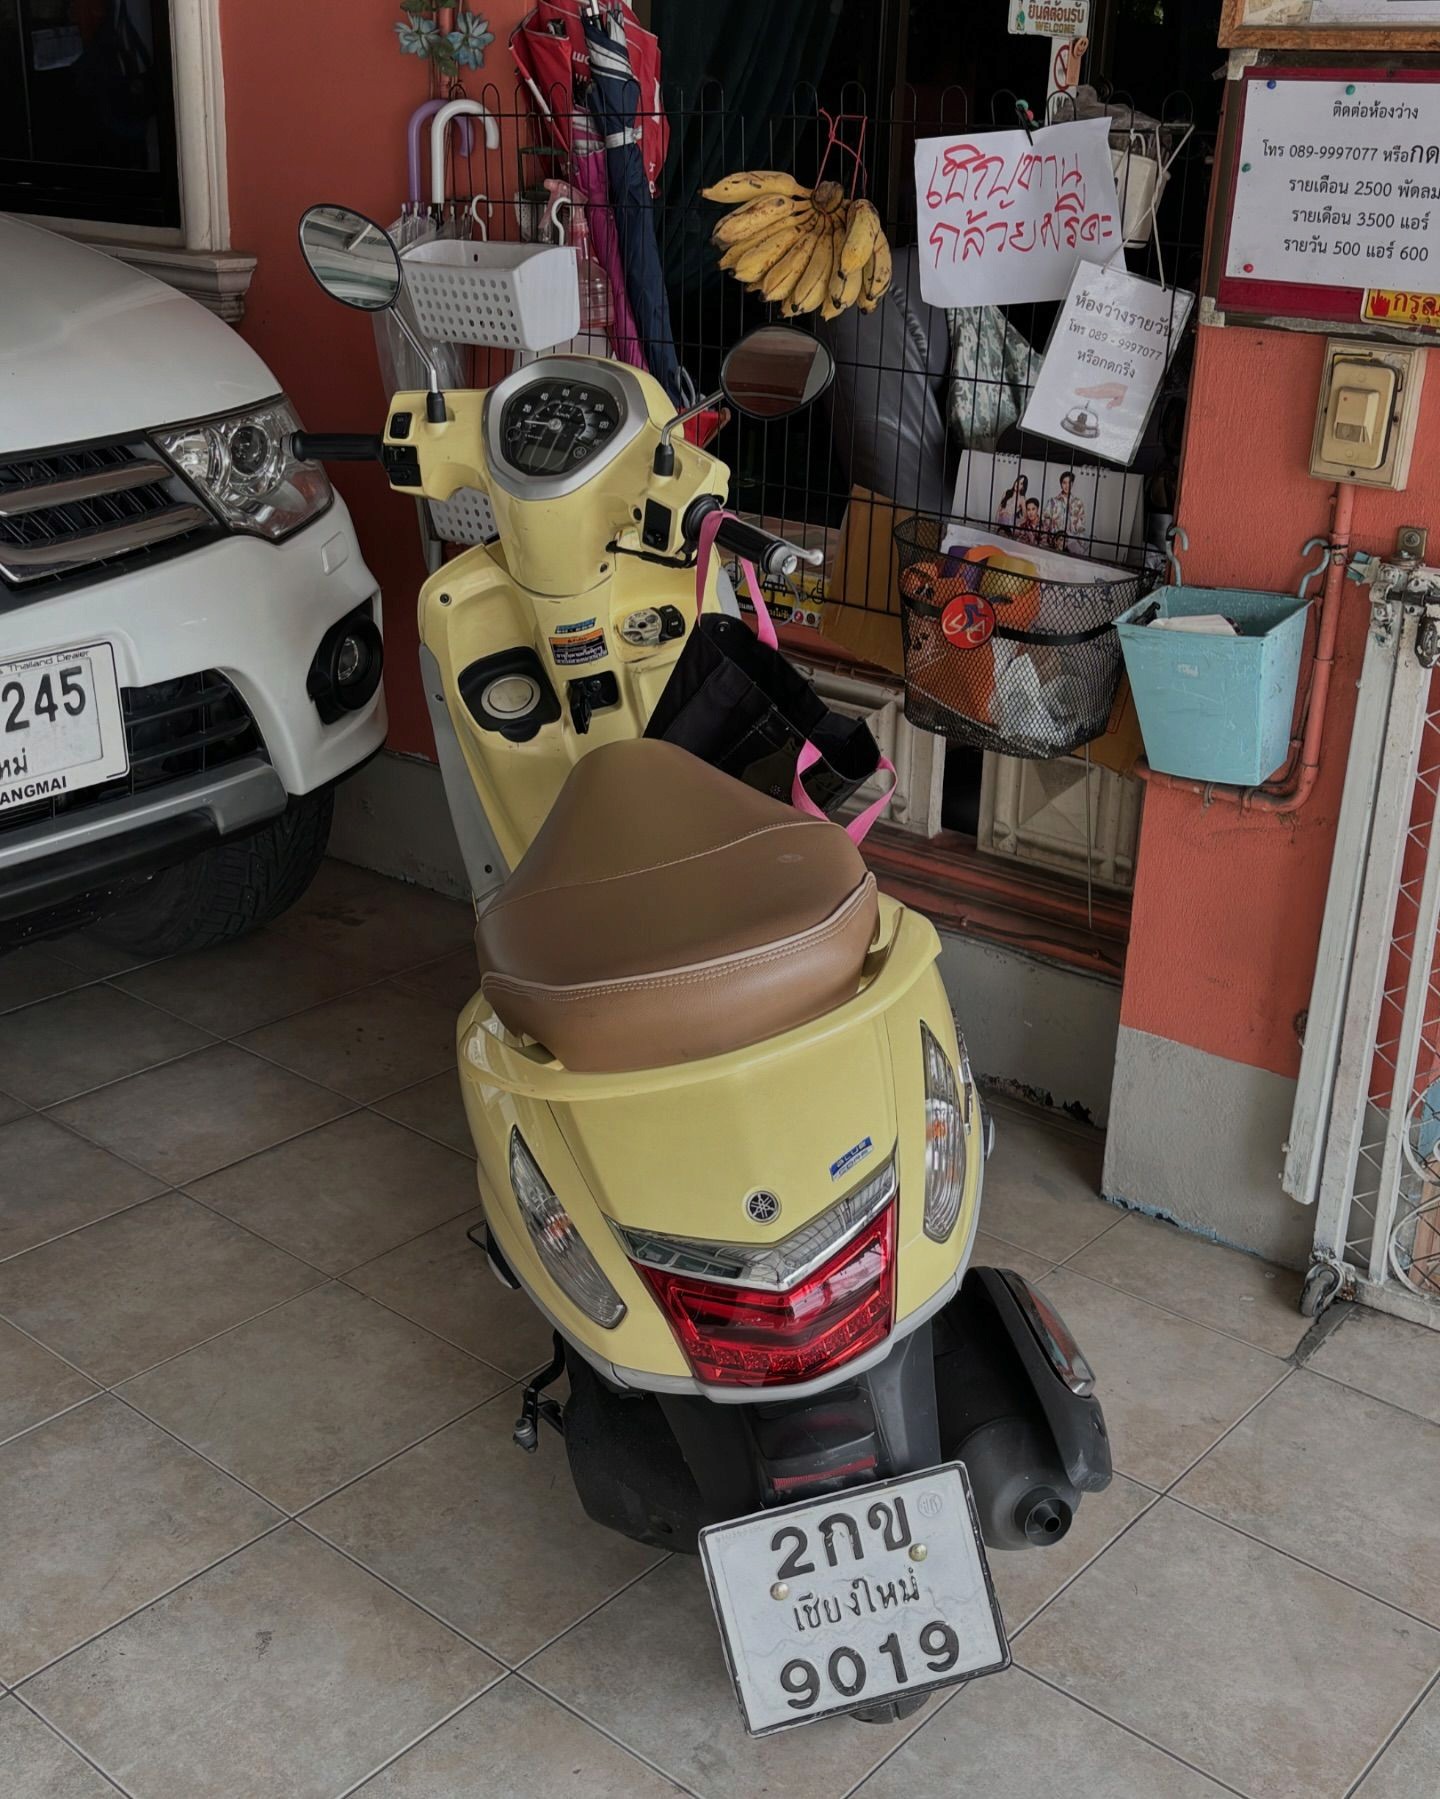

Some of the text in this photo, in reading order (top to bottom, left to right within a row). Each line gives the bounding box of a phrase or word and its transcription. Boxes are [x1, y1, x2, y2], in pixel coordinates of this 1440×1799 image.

[1035, 21, 1075, 34] WELCOME
[1333, 100, 1419, 119] ติดต่อห้องว่าง
[1263, 139, 1284, 157] โทร
[1289, 144, 1378, 161] 089-9997077
[1289, 175, 1440, 200] รายเดือน 2500 พัดลม
[1292, 206, 1430, 230] รายเดือน 3500 แอร์
[1284, 236, 1429, 261] รายวัน 500 แอร์ 600
[1076, 290, 1173, 337] ห้องว่างรายวัน
[1069, 318, 1087, 335] โทร
[1089, 328, 1108, 342] 089
[1118, 339, 1162, 360] 9997077
[1077, 348, 1135, 378] หรือกดกริ่ง
[8, 650, 91, 673] Thailand Dealer
[2, 666, 86, 734] 245
[0, 775, 67, 806] ANGMAI
[836, 1141, 865, 1168] BLUE
[770, 1496, 912, 1580] 2กข
[793, 1567, 920, 1631] เชียงใหม่
[780, 1620, 960, 1709] 9019
